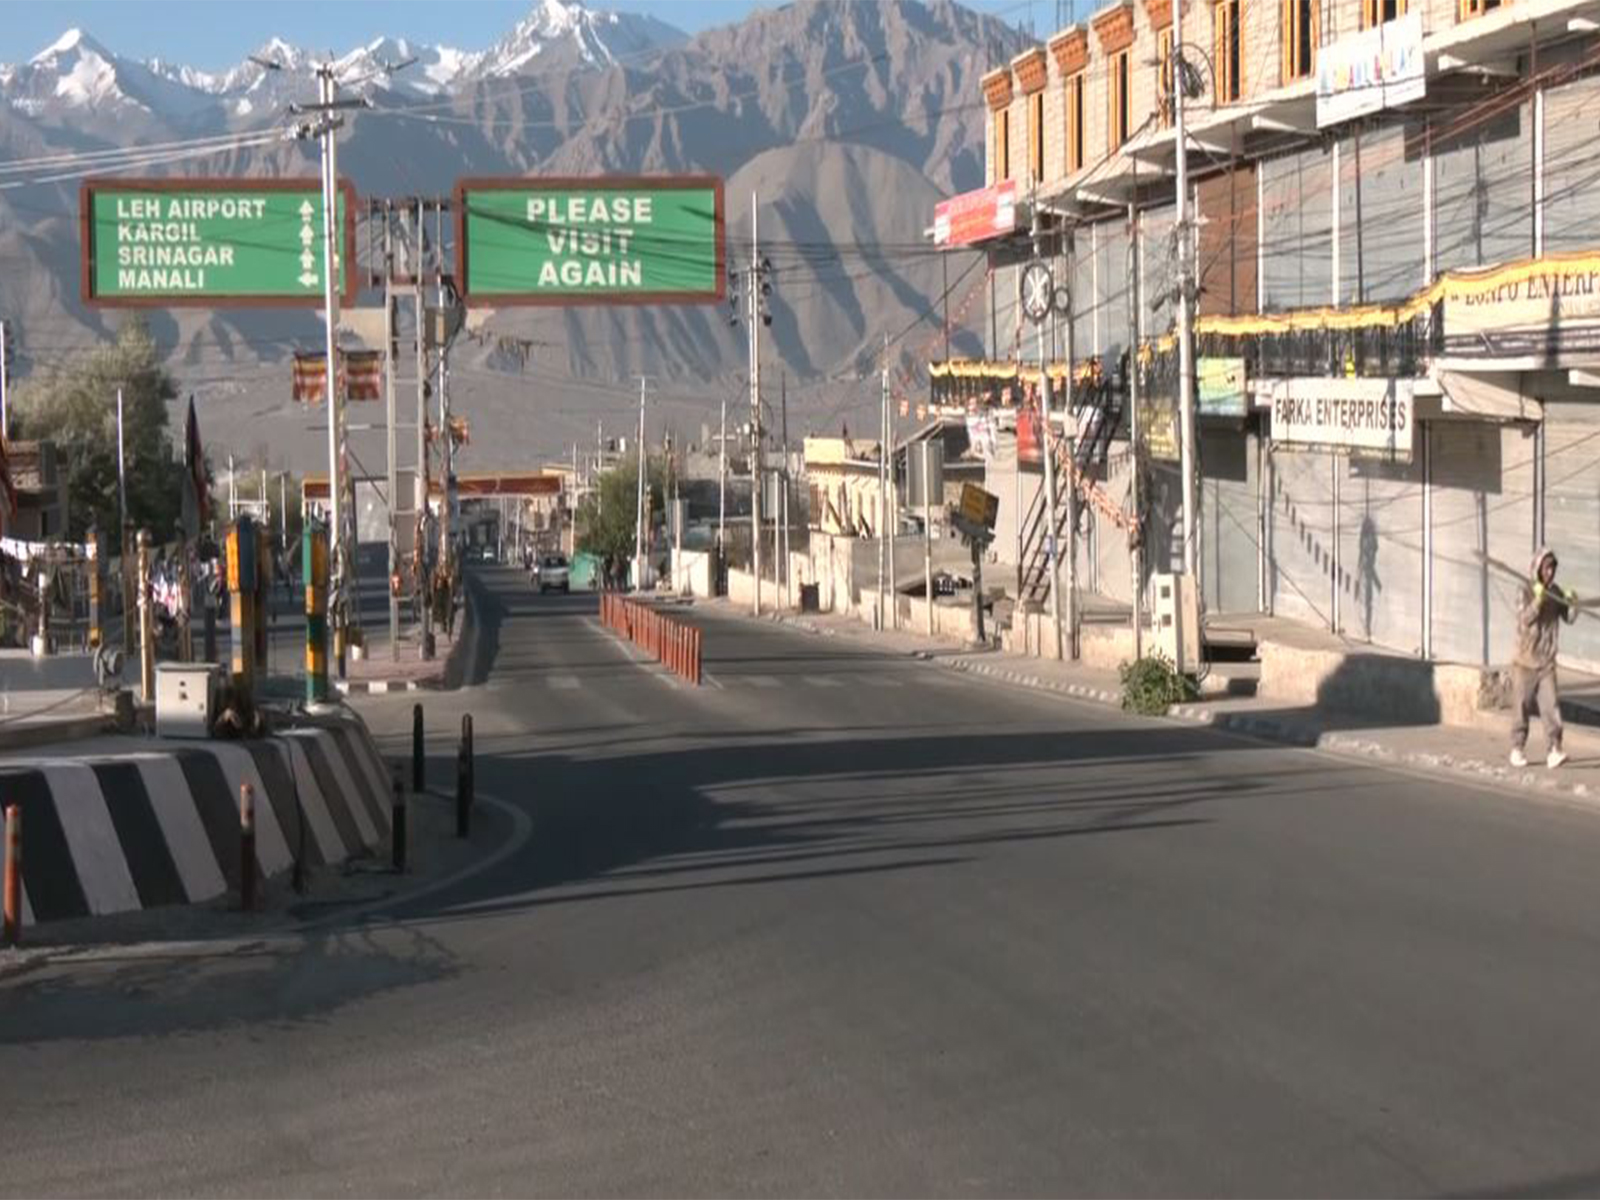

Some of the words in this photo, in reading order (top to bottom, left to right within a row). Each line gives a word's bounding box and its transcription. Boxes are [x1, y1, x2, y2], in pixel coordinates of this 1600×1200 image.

[117, 199, 160, 219] LEH
[168, 199, 266, 219] AIRPORT
[526, 197, 652, 223] PLEASE
[117, 222, 200, 242] KARGIL
[547, 228, 634, 255] VISIT
[118, 246, 234, 265] SRINAGAR
[118, 269, 204, 289] MANALI
[537, 260, 642, 286] AGAIN
[1316, 398, 1407, 431] ENTERPRISES
